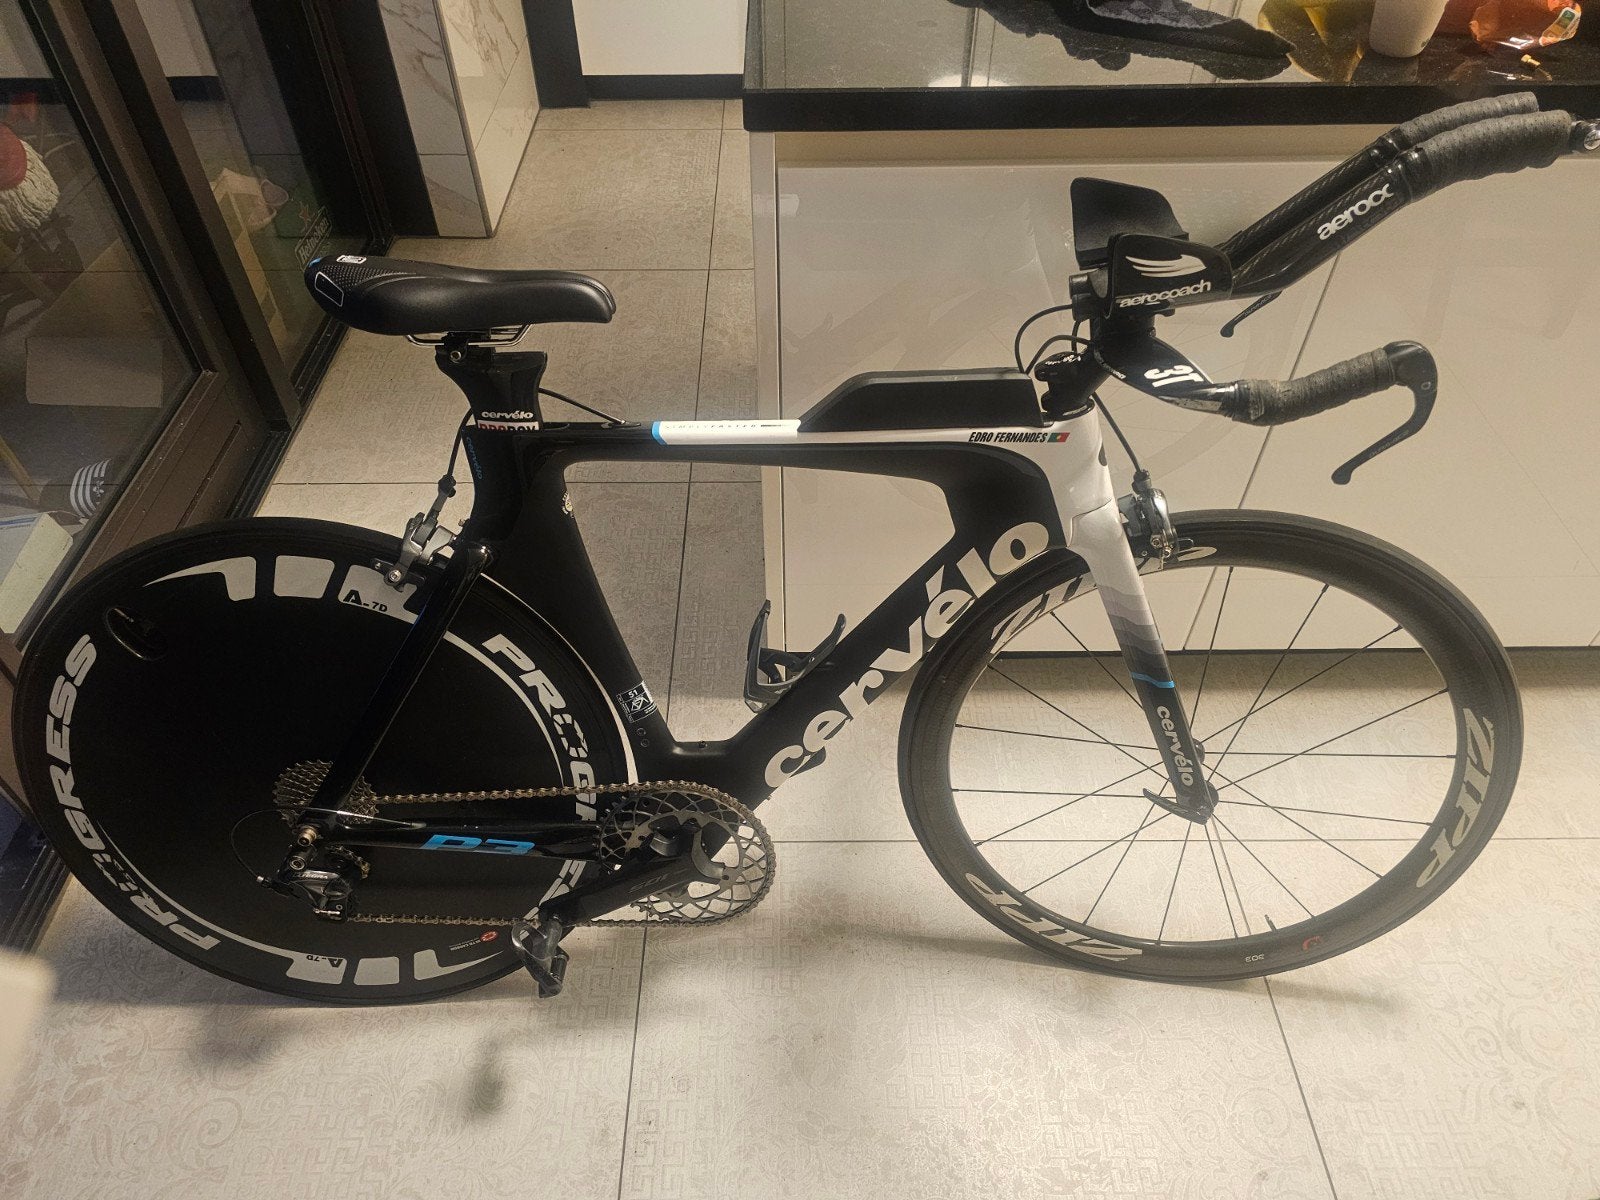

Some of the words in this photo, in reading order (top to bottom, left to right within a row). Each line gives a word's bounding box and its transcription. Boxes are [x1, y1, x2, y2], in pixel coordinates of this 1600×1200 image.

[1119, 278, 1212, 308] aerocoach
[481, 409, 534, 420] cervélo
[968, 431, 994, 443] EDRO
[994, 431, 1048, 443] FERNANDES
[342, 588, 389, 613] A-7D
[763, 521, 1050, 789] cervélo
[1156, 705, 1195, 787] cervélo
[45, 633, 221, 951] PROGRESS
[1416, 707, 1495, 888] ZIPP
[964, 872, 1143, 962] ZIPP
